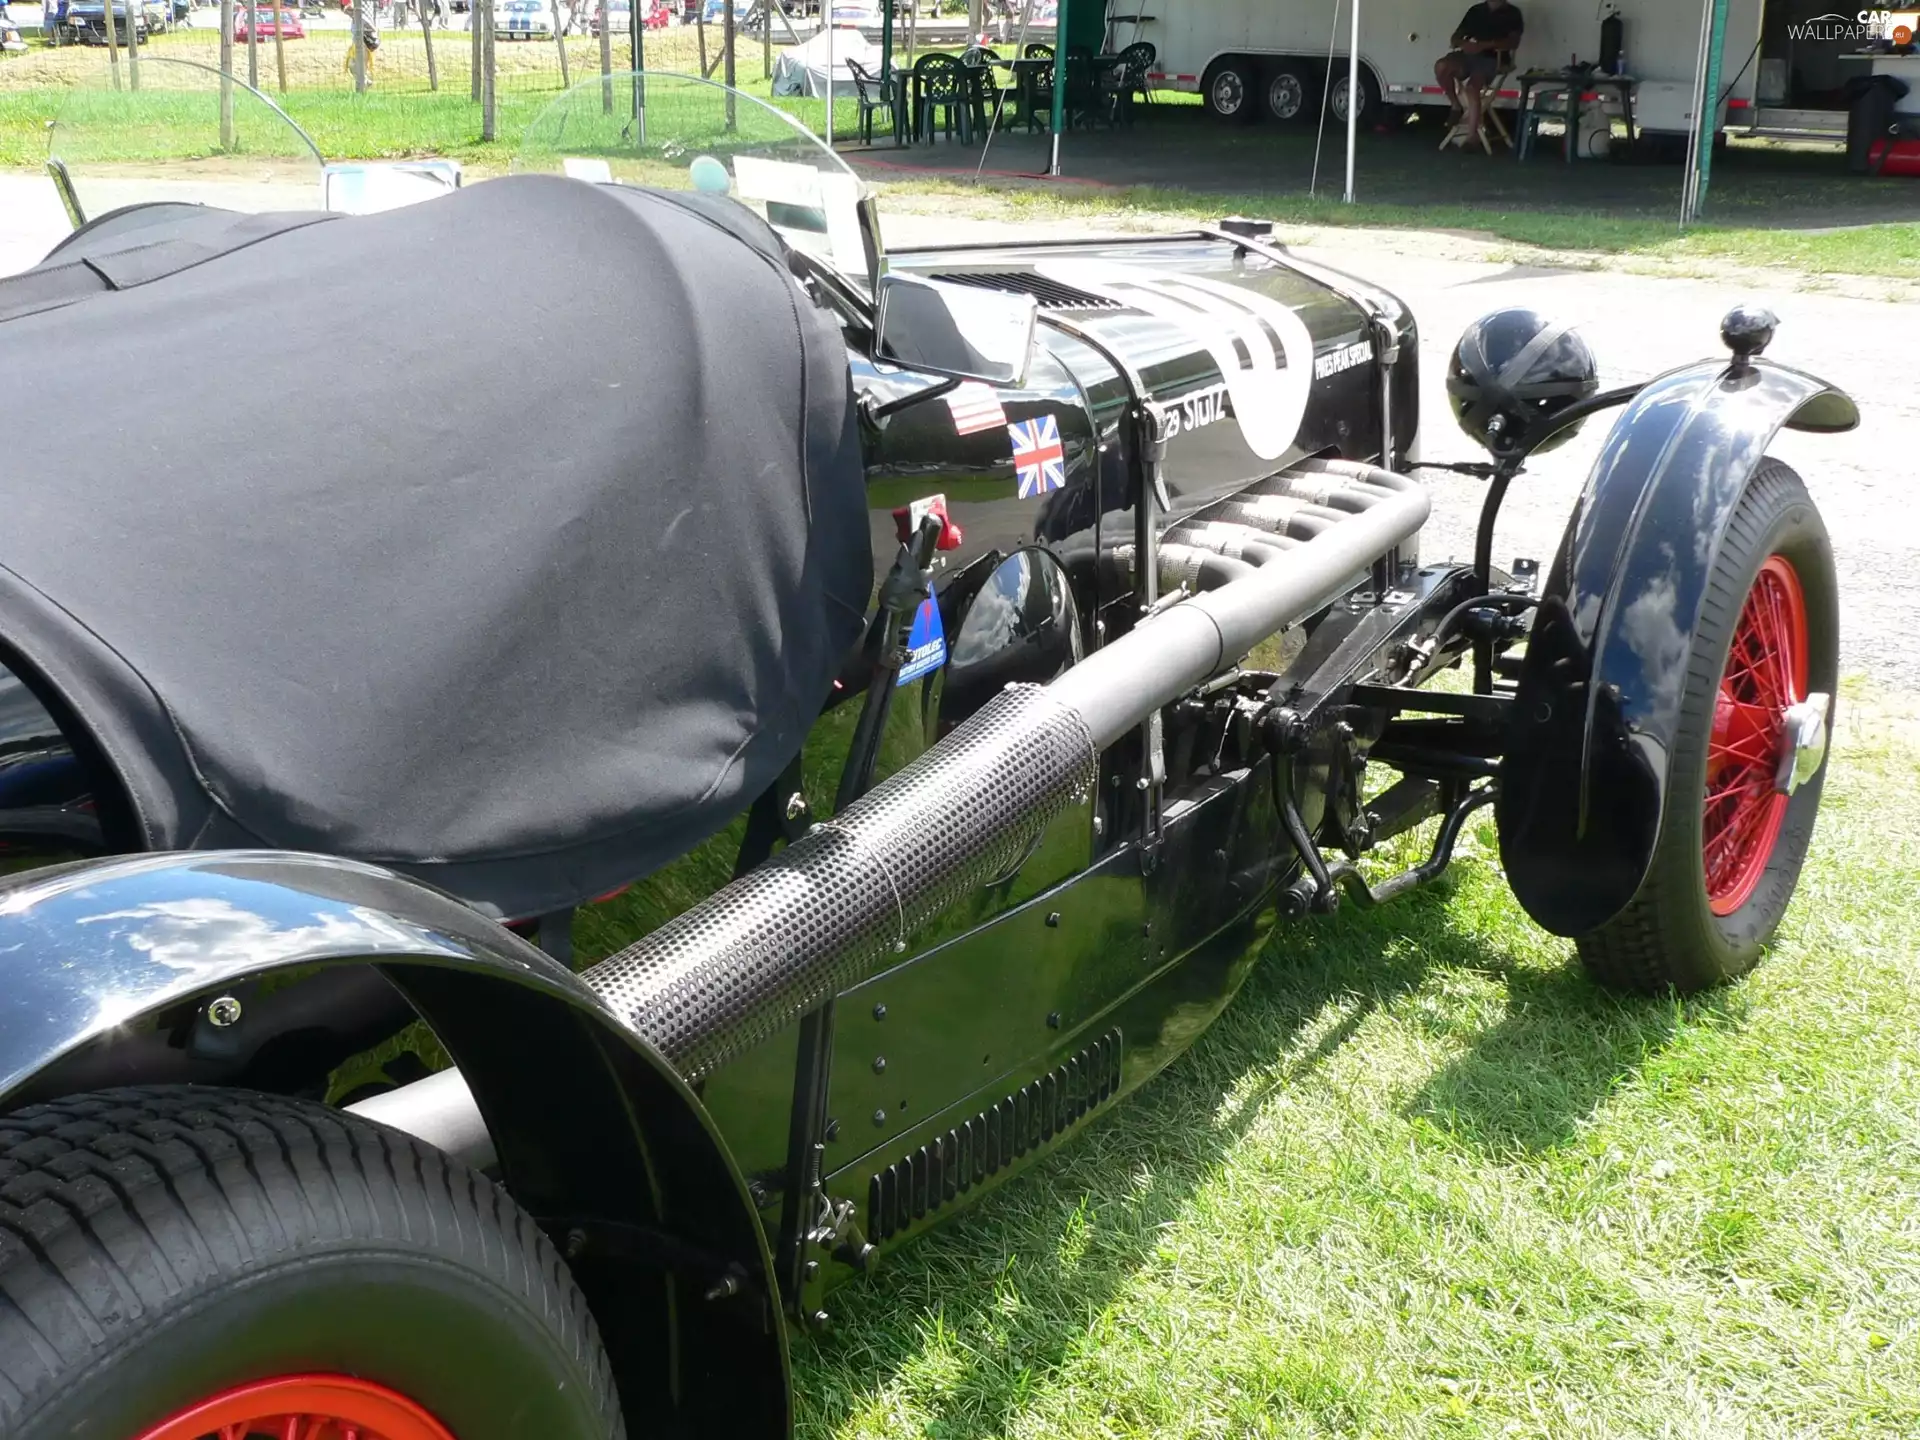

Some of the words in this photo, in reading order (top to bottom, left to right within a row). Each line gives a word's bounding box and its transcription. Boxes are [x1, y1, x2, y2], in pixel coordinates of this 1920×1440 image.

[1332, 348, 1350, 373] PEAK
[1349, 340, 1373, 367] SPECIAL
[1183, 386, 1226, 432] STUTZ
